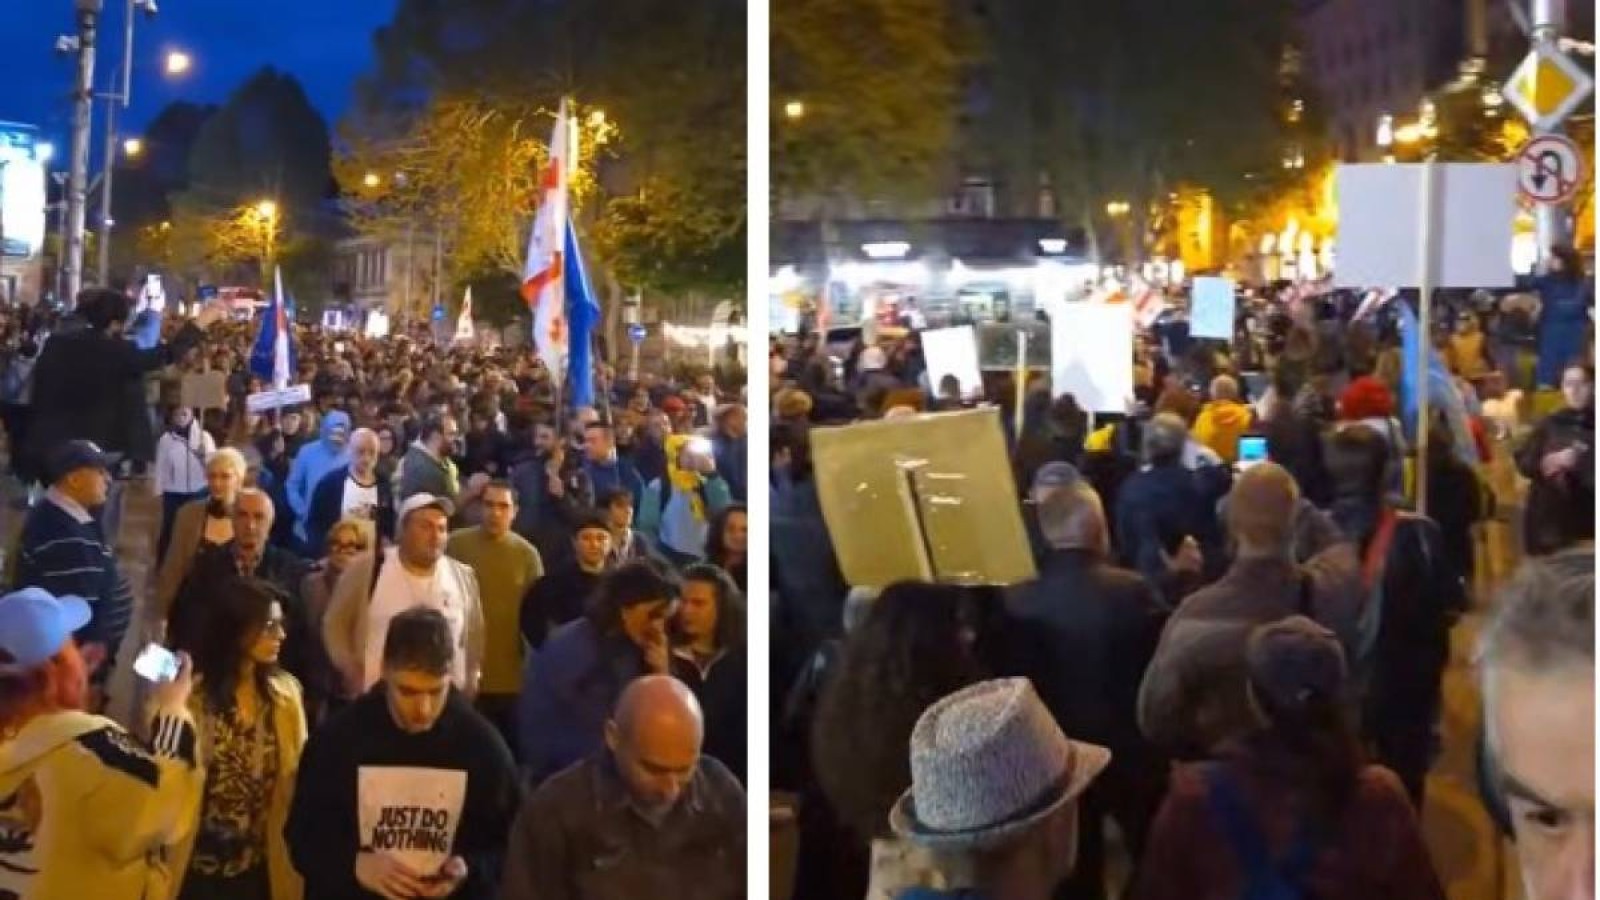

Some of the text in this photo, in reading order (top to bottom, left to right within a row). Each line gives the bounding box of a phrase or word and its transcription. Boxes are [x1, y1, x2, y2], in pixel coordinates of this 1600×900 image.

[378, 807, 448, 829] JUST DO
[373, 828, 448, 852] NOTHING
